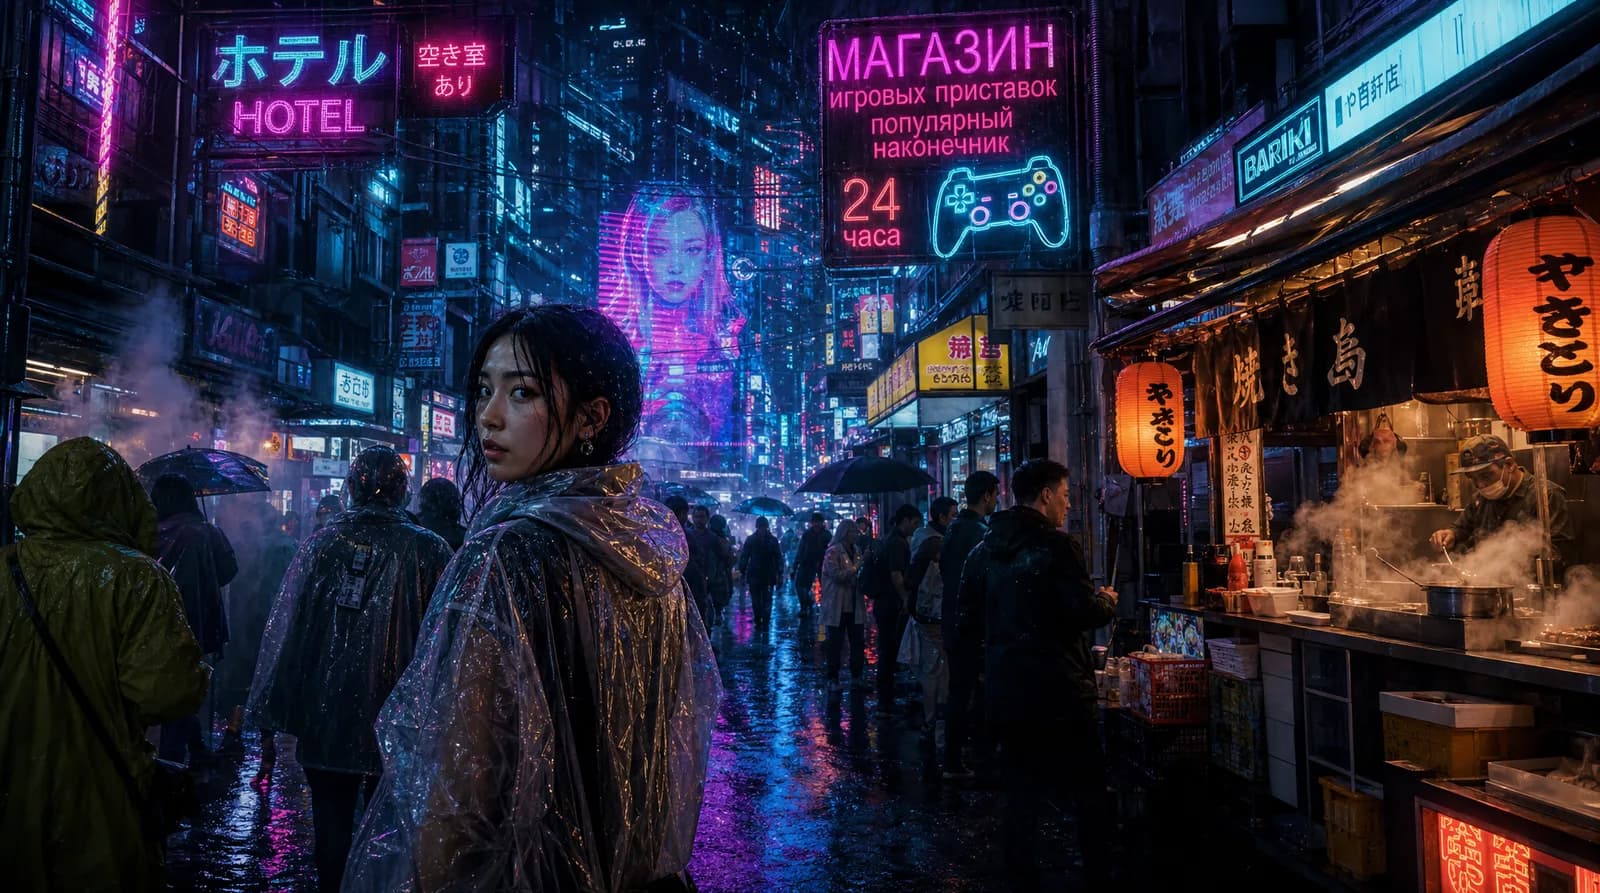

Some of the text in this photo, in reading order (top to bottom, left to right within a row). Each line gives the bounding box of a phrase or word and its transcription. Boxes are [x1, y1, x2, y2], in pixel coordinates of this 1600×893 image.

[212, 34, 386, 88] ホテル
[418, 42, 486, 67] 空き室
[828, 24, 1054, 82] МАГАЗИН
[435, 74, 472, 97] あり
[830, 79, 1058, 113] игровых приставок
[233, 99, 365, 134] HOTEL
[871, 106, 1013, 138] популярный
[874, 135, 1010, 159] наконечник
[843, 177, 900, 222] 24
[843, 228, 901, 248] часа
[1528, 253, 1595, 412] やきとり
